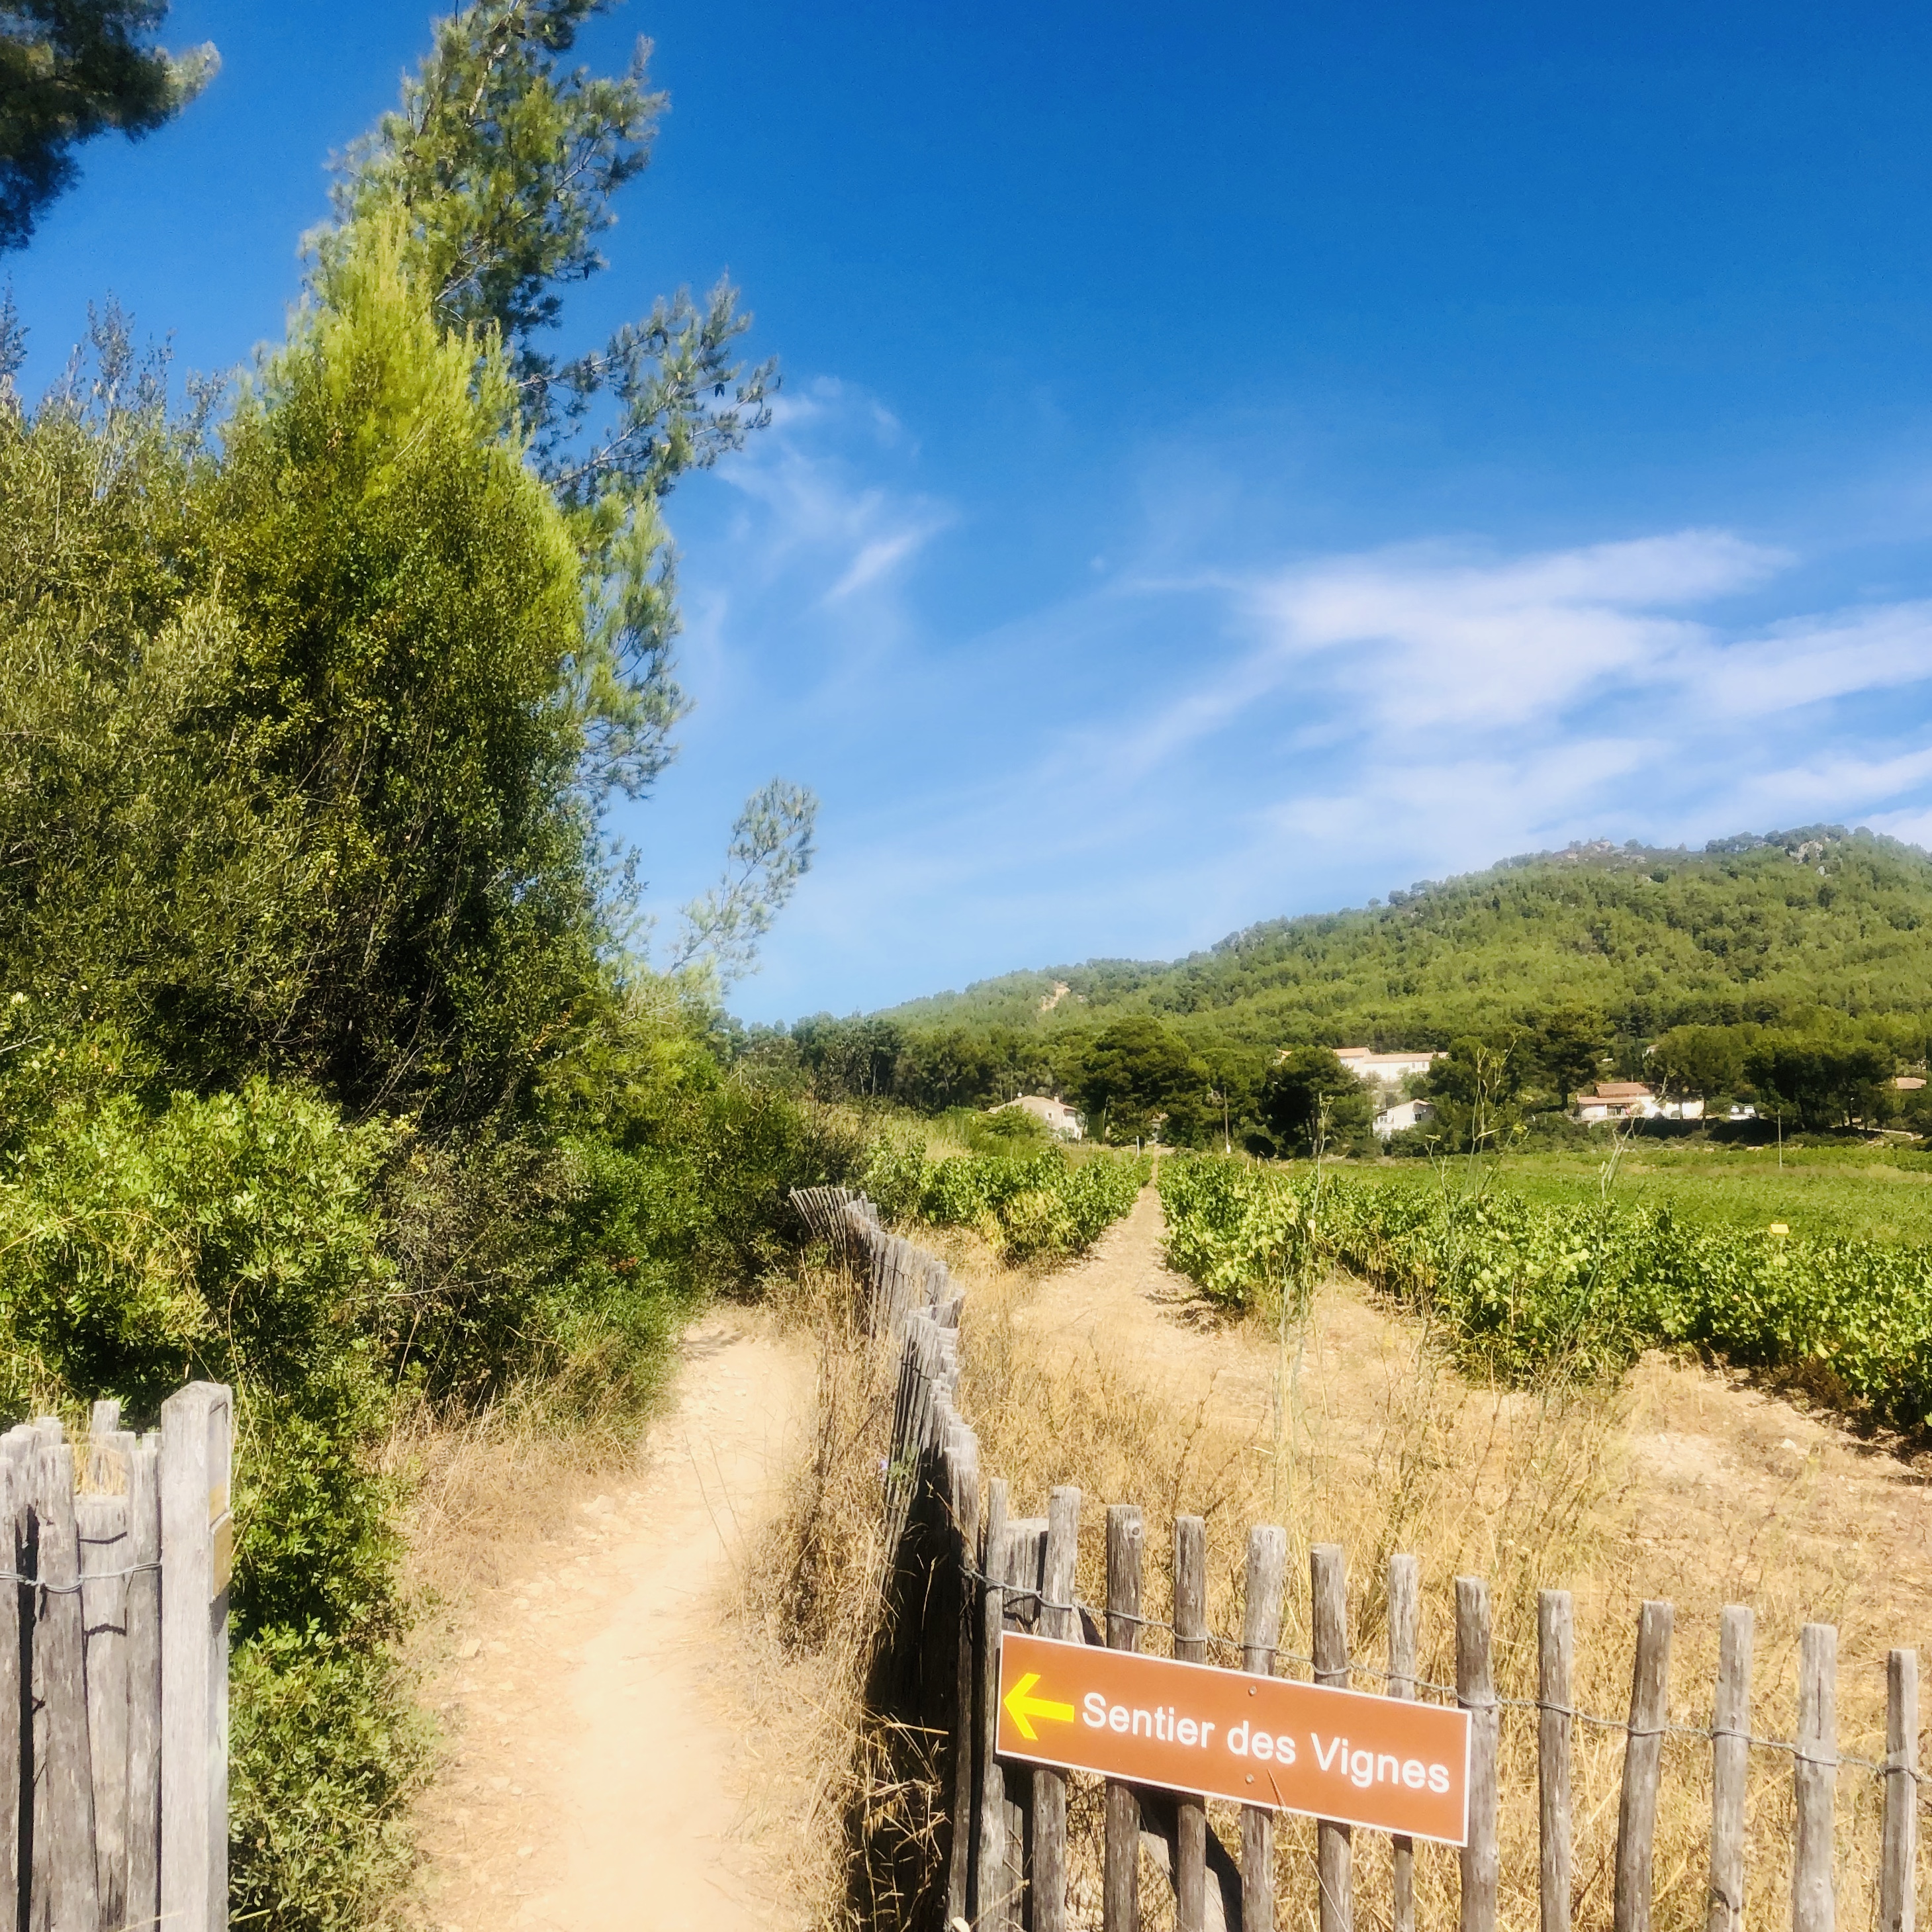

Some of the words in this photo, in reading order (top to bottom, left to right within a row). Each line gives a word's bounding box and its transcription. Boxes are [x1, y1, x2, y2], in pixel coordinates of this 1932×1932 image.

[1081, 1692, 1215, 1748] Sentier
[1226, 1720, 1297, 1765] des
[1311, 1732, 1451, 1794] Vignes
